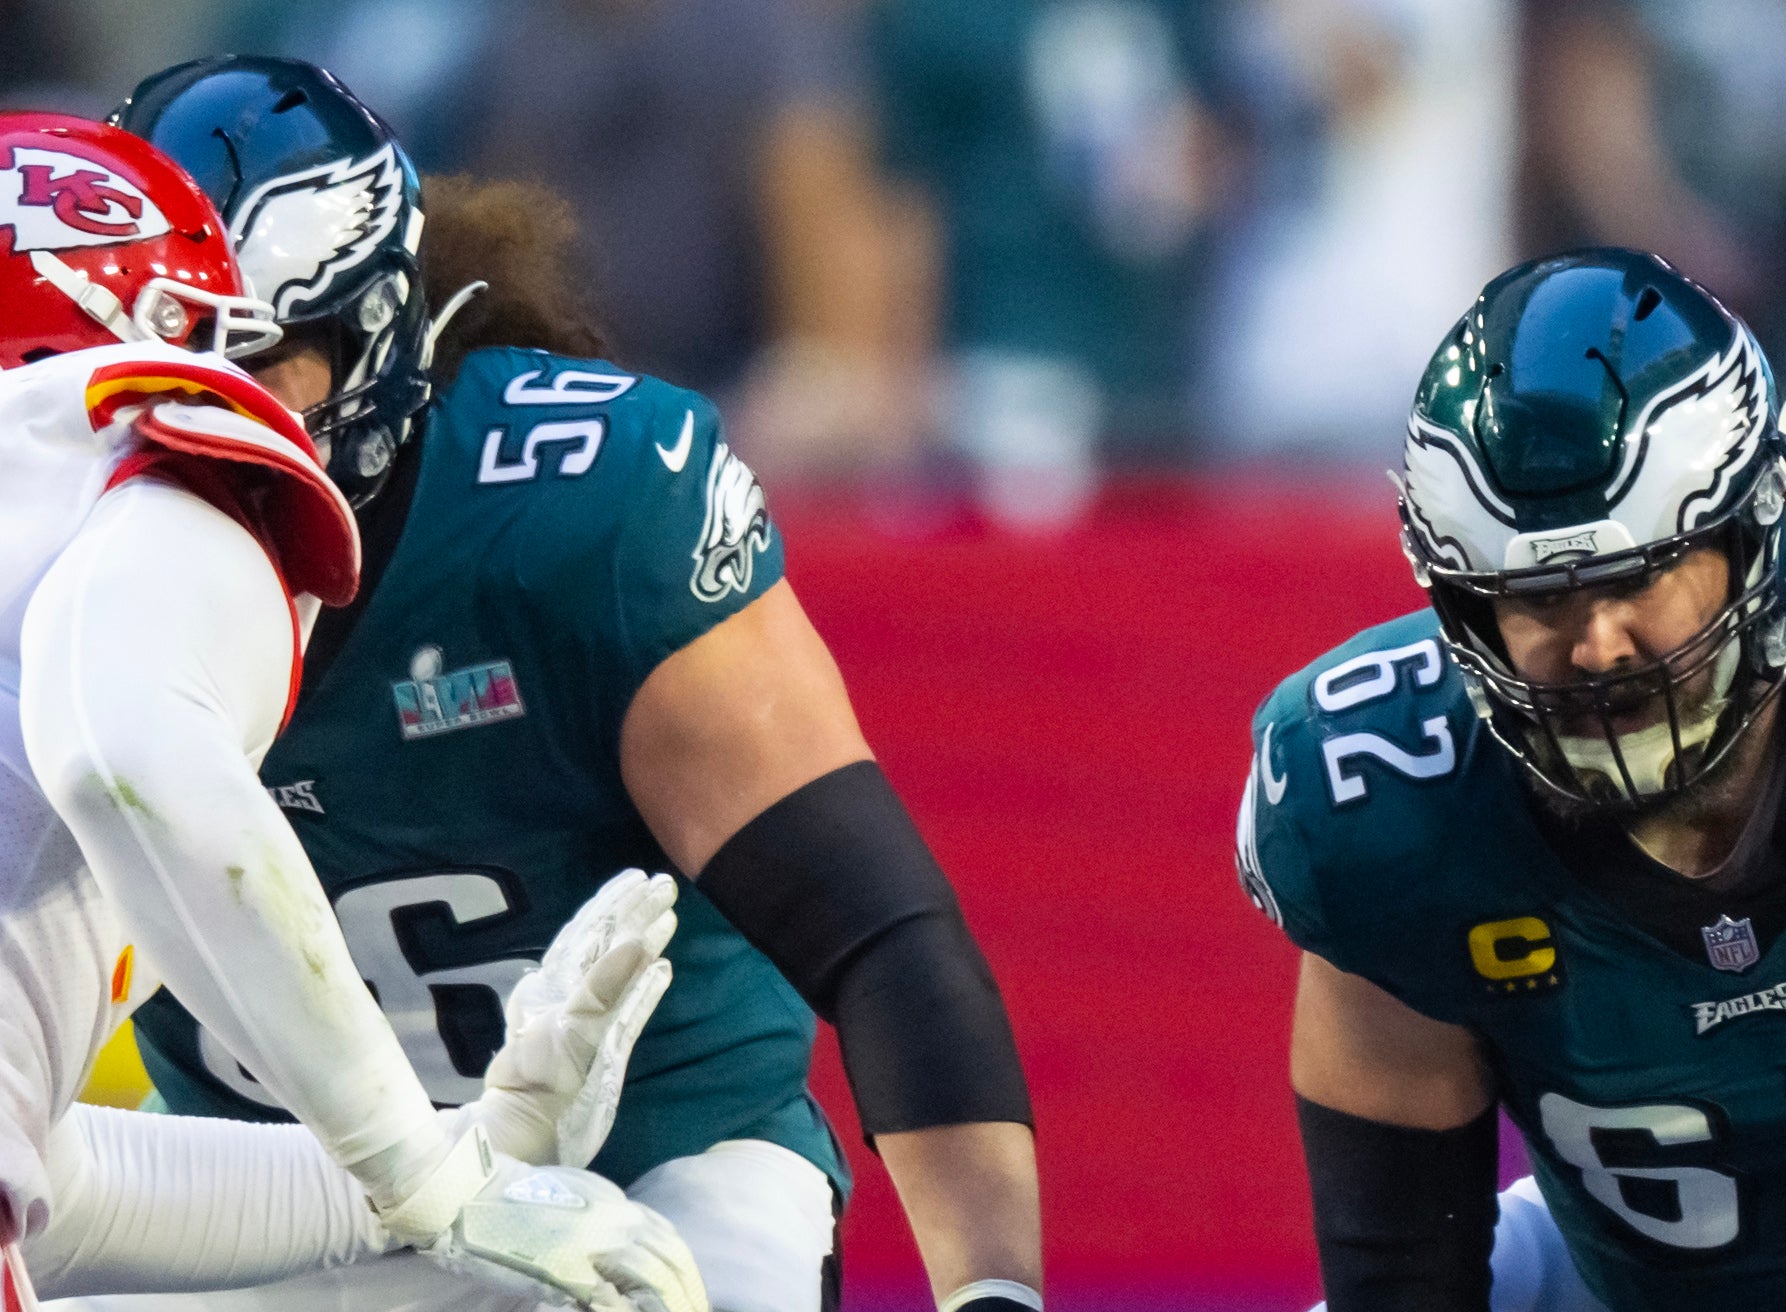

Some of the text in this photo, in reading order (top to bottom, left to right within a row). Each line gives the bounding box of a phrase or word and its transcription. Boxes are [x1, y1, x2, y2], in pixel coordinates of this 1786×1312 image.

[18, 165, 142, 236] KC
[478, 370, 636, 483] 56
[1314, 639, 1455, 803] 62
[1468, 917, 1556, 980] C
[1713, 940, 1752, 964] NFL
